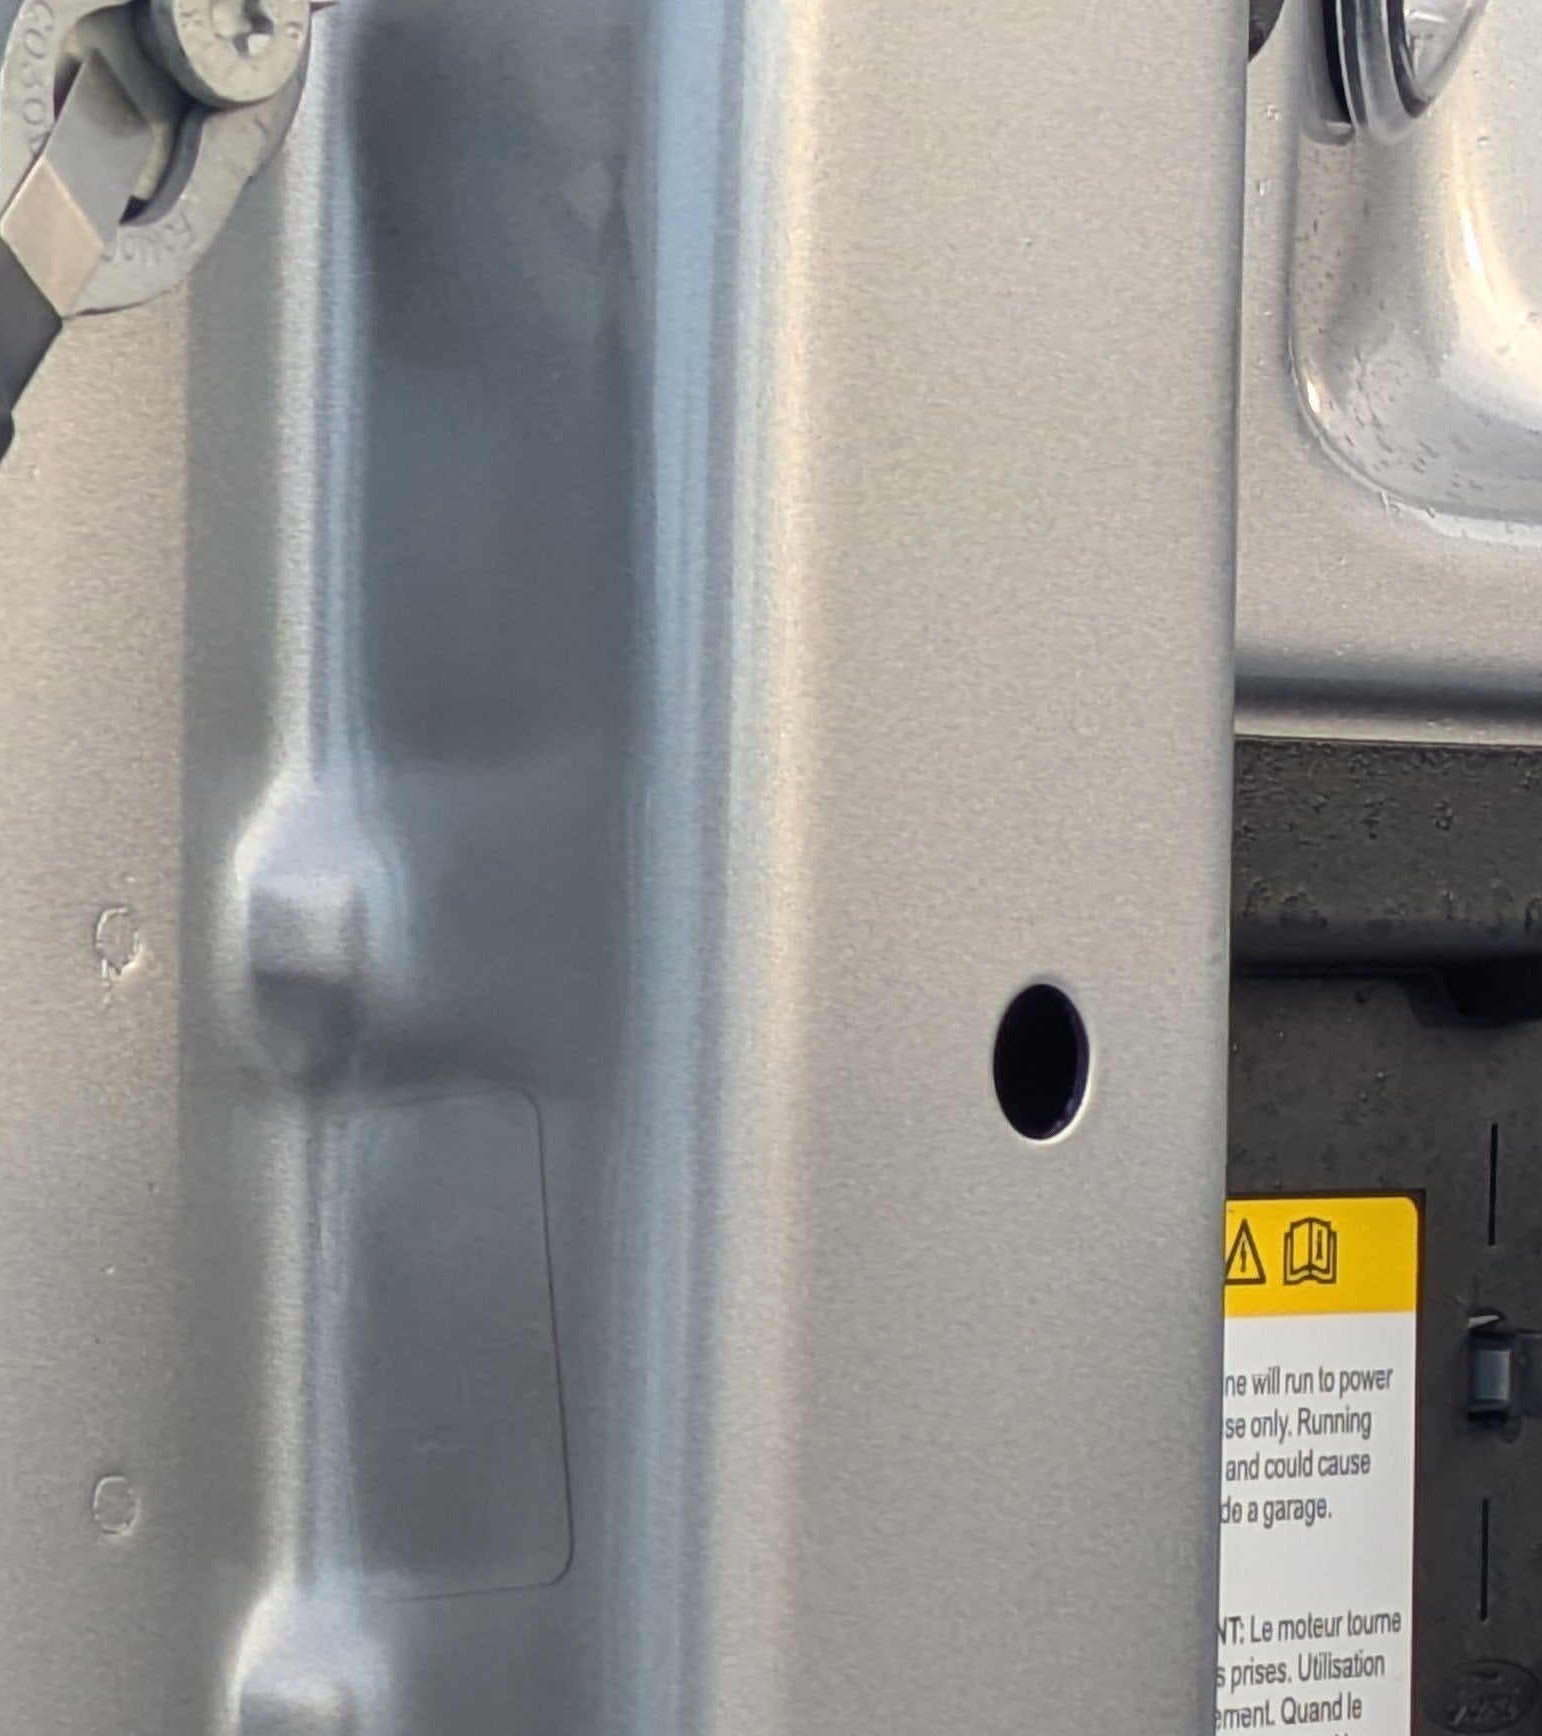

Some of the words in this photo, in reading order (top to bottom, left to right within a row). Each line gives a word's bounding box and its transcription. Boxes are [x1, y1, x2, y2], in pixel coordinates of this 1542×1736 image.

[1252, 1366, 1281, 1395] will
[1285, 1370, 1314, 1394] run
[1318, 1366, 1335, 1393] to
[1339, 1368, 1394, 1399] power
[1251, 1408, 1292, 1446] only.
[1297, 1404, 1372, 1441] Running
[1226, 1451, 1260, 1481] and
[1264, 1449, 1313, 1479] could
[1318, 1453, 1371, 1477] cause
[1247, 1501, 1258, 1523] a
[1263, 1497, 1332, 1529] garage.
[1250, 1615, 1272, 1643] Le
[1278, 1612, 1343, 1641] moteur
[1231, 1657, 1292, 1694] prises.
[1298, 1649, 1385, 1682] Utilisation
[1281, 1691, 1343, 1725] Quand
[1347, 1691, 1362, 1720] le
